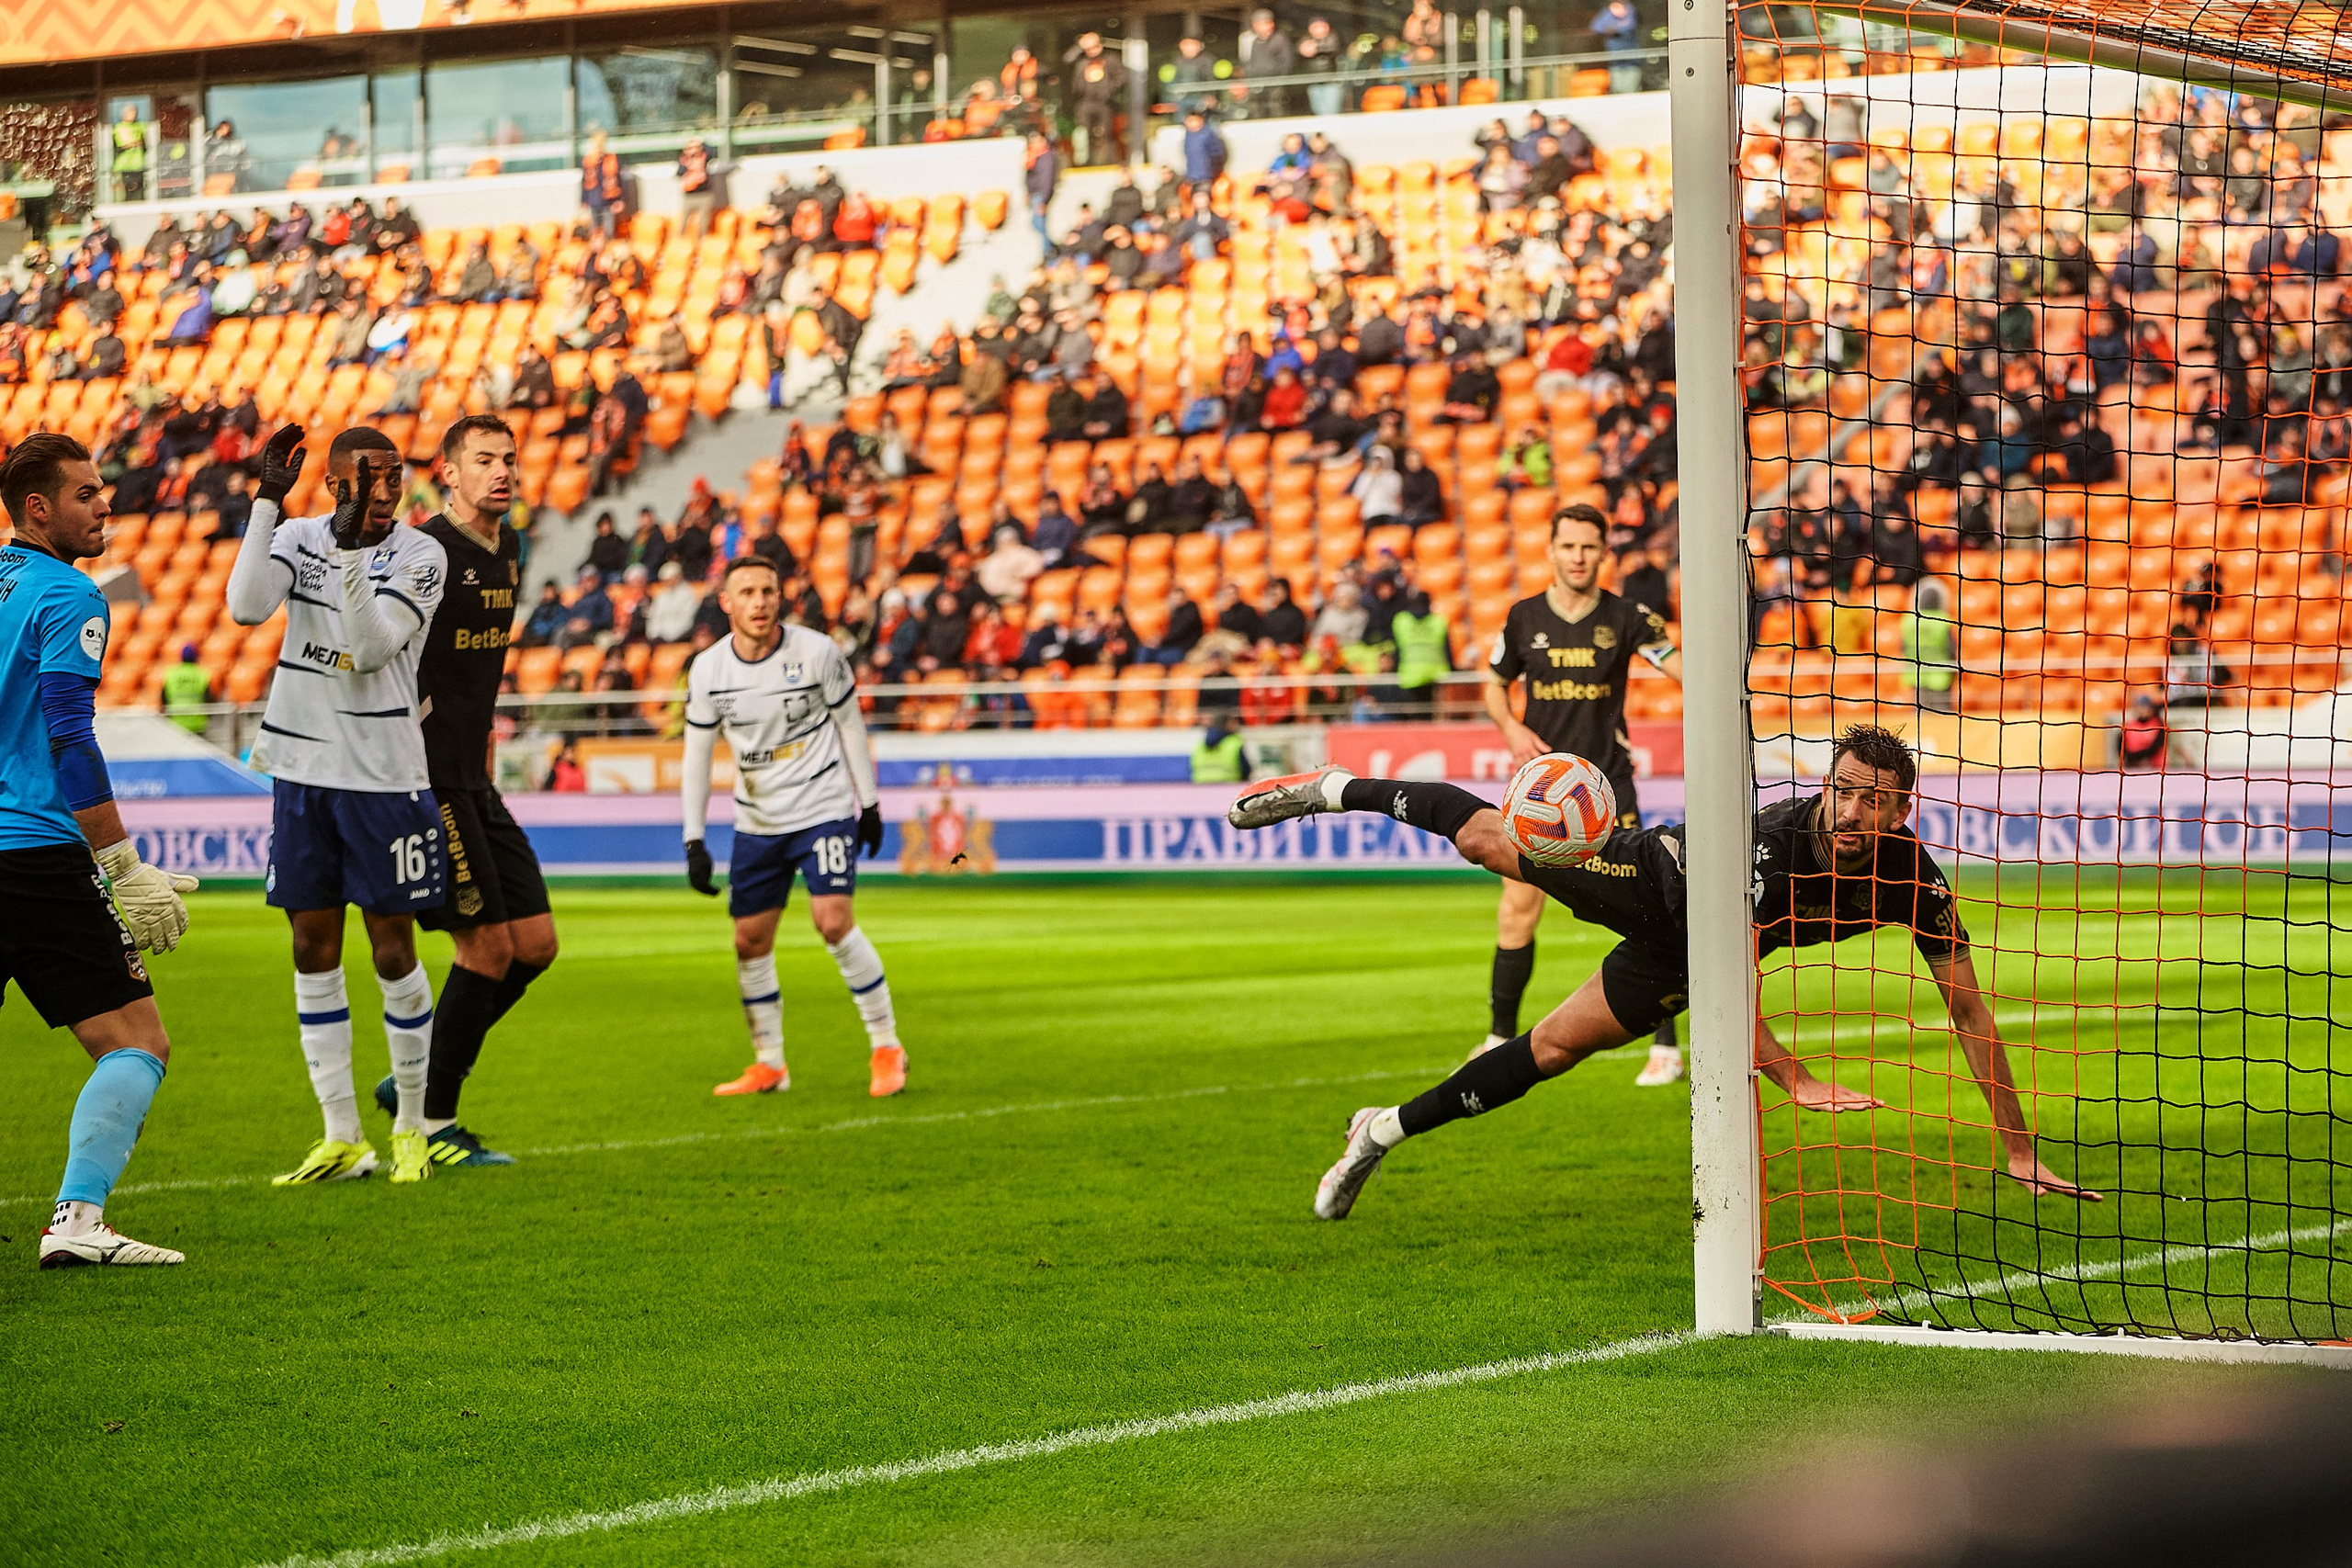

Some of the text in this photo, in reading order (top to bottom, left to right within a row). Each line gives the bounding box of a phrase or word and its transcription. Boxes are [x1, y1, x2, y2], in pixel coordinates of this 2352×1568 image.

[301, 641, 354, 671] МЕЛБ
[389, 833, 426, 885] 16
[811, 835, 847, 875] 18
[1102, 816, 1464, 864] ПРАВИТЕЛЬ
[1575, 855, 1637, 878] tBoom
